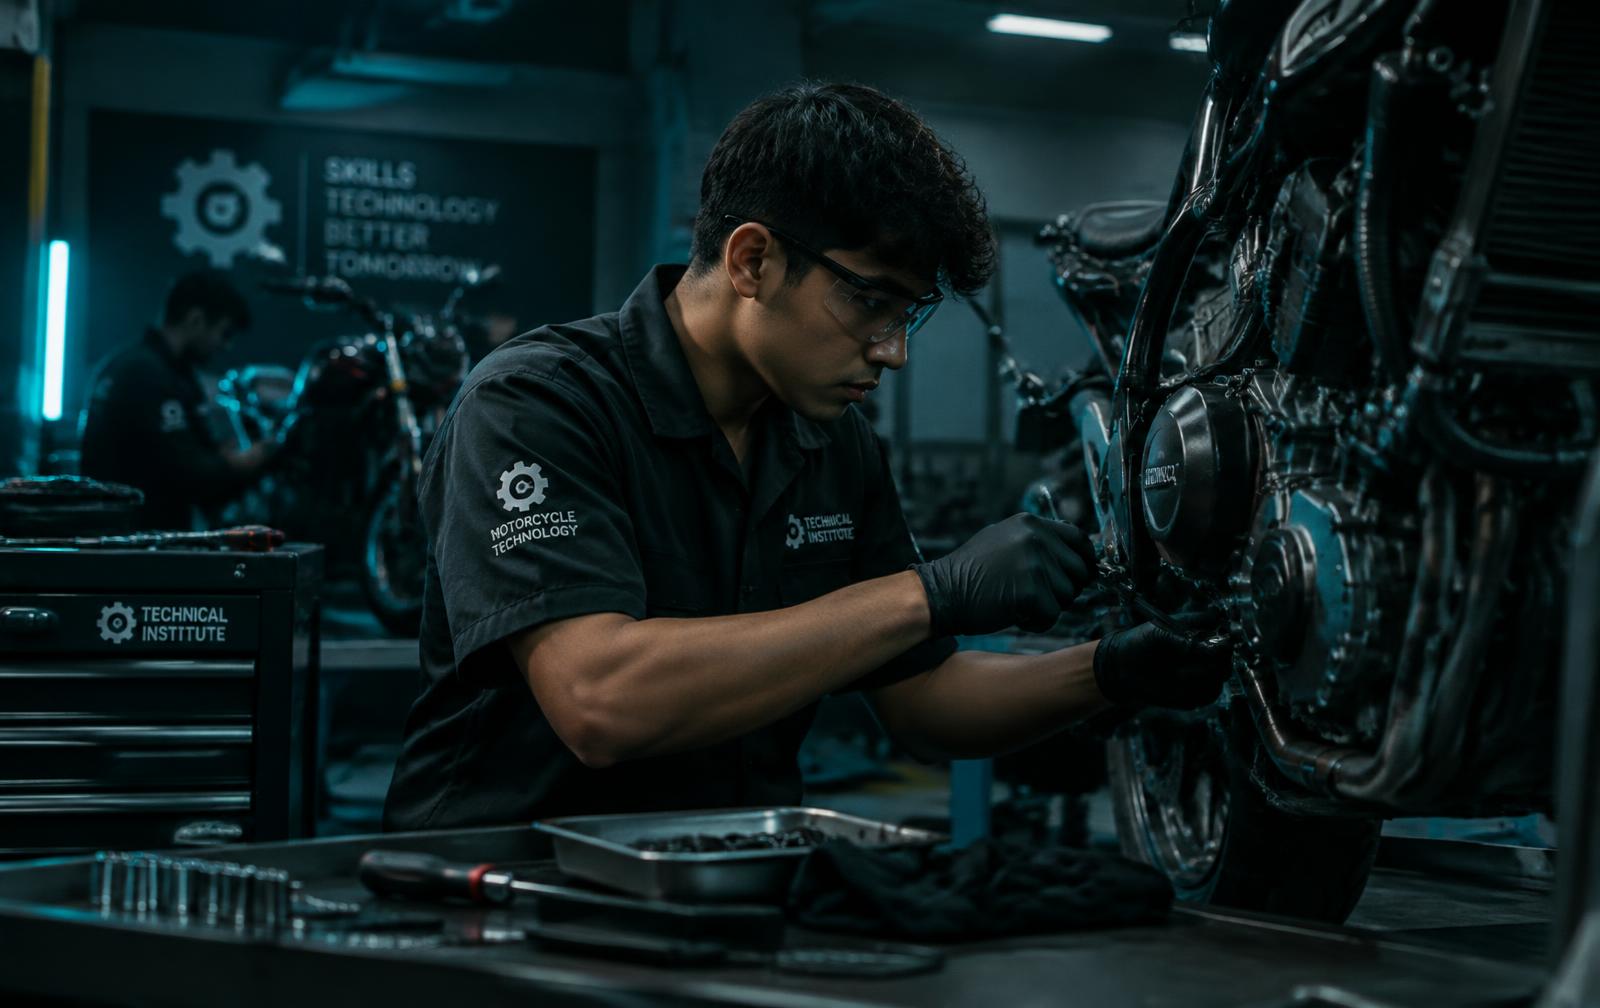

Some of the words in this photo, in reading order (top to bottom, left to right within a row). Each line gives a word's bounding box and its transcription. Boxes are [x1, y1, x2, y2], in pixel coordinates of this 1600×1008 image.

[323, 155, 417, 190] SKILLS
[324, 187, 499, 224] TECHNOLOGY
[323, 217, 430, 249] BETTER
[490, 510, 577, 541] MOTORCYCLE
[491, 525, 578, 556] TECHNOLOGY
[140, 605, 228, 623] TECHNICAL
[141, 625, 226, 642] INSTITUTE
